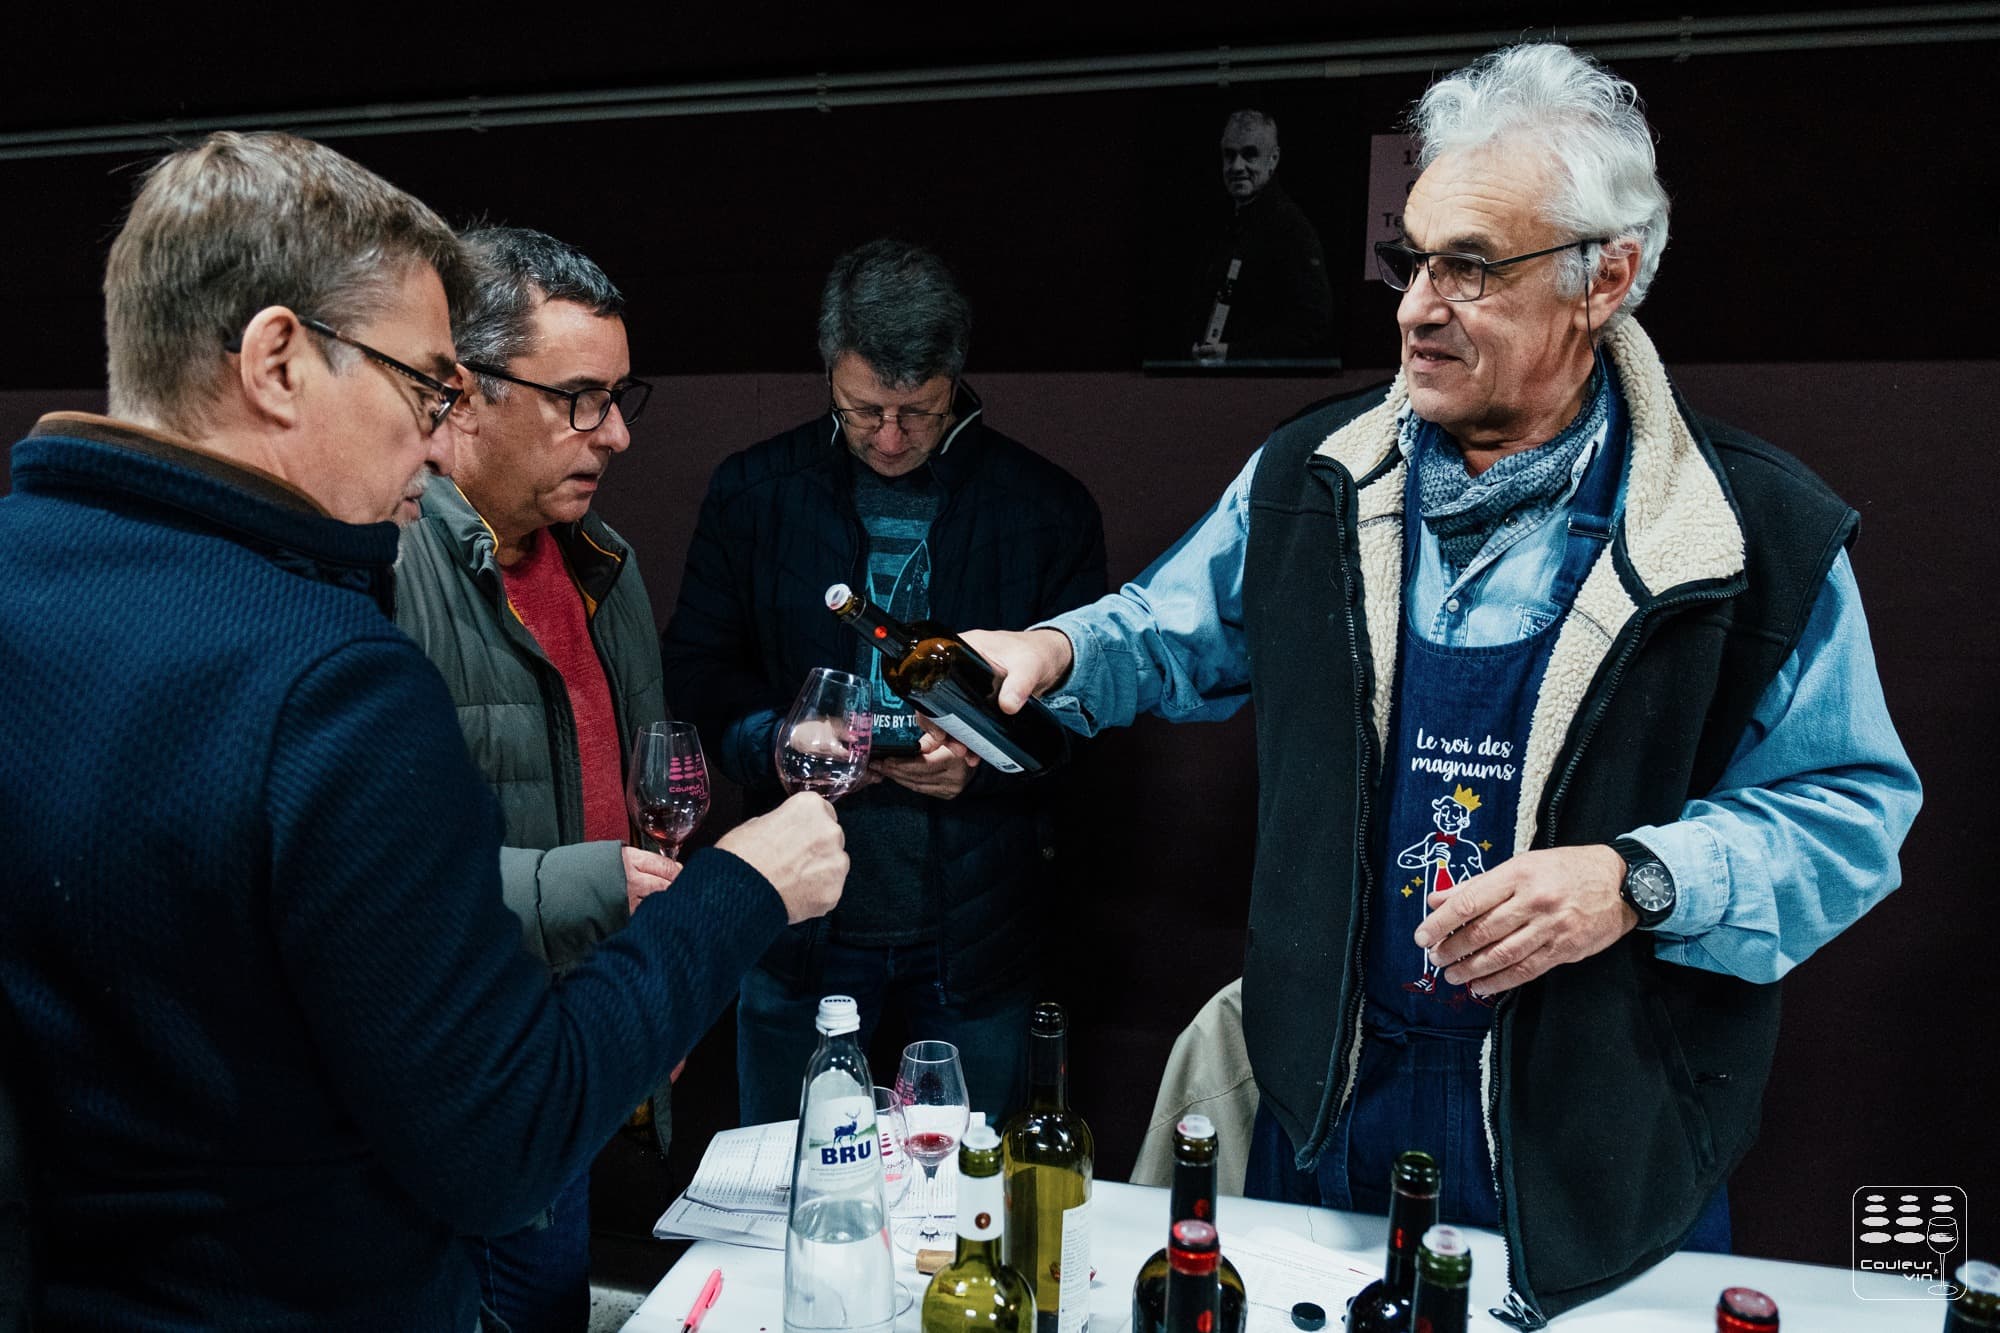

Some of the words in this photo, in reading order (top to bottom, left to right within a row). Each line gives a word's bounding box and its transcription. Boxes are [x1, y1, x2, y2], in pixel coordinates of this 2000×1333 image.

[1382, 212, 1403, 228] Te
[873, 712, 891, 729] VES
[892, 714, 905, 729] BY
[906, 714, 919, 728] TO
[1416, 727, 1437, 750] Le
[1438, 734, 1473, 755] roi
[1477, 734, 1514, 759] des
[1411, 755, 1517, 782] magnums
[820, 1139, 872, 1165] BRU
